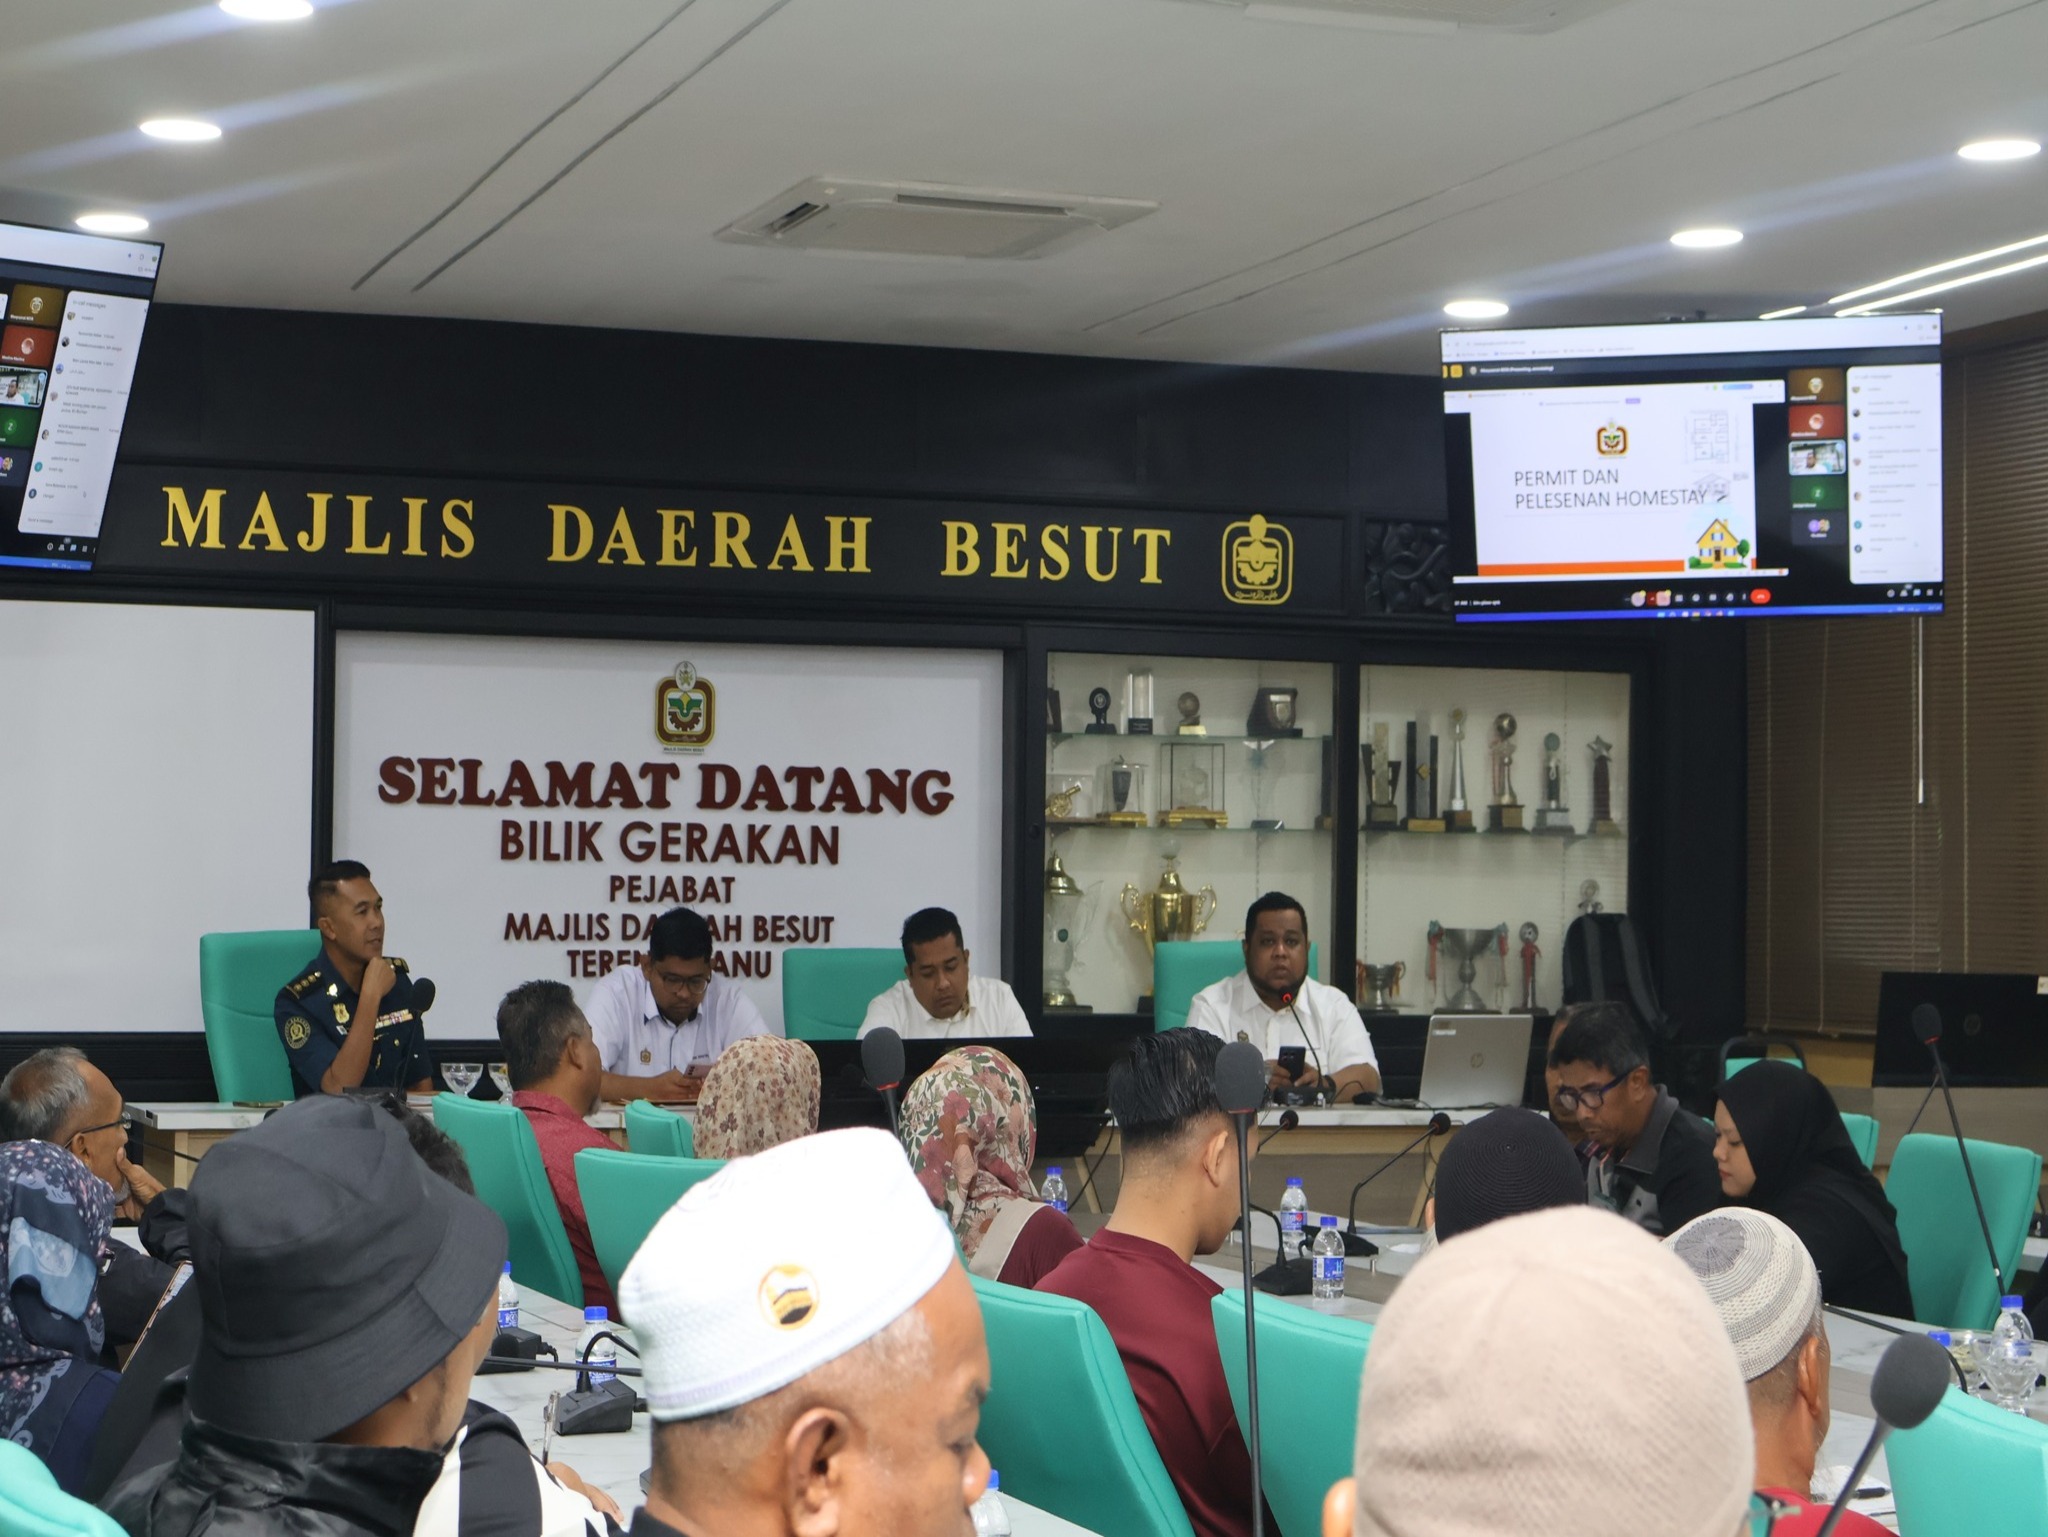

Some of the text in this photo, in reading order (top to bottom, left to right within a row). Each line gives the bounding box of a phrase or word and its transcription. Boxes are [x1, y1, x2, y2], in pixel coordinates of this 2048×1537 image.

[1513, 469, 1619, 487] PERMIT DAN
[1515, 489, 1708, 509] PELESENAN HOMESTAY
[160, 486, 1172, 584] MAJLIS DAERAH BESUT
[379, 756, 954, 816] SELAMAT DATANG
[500, 820, 840, 865] BILIK GERAKAN
[609, 875, 735, 903] PEJABAT
[504, 912, 834, 944] MAJLIS DAAH BESUT
